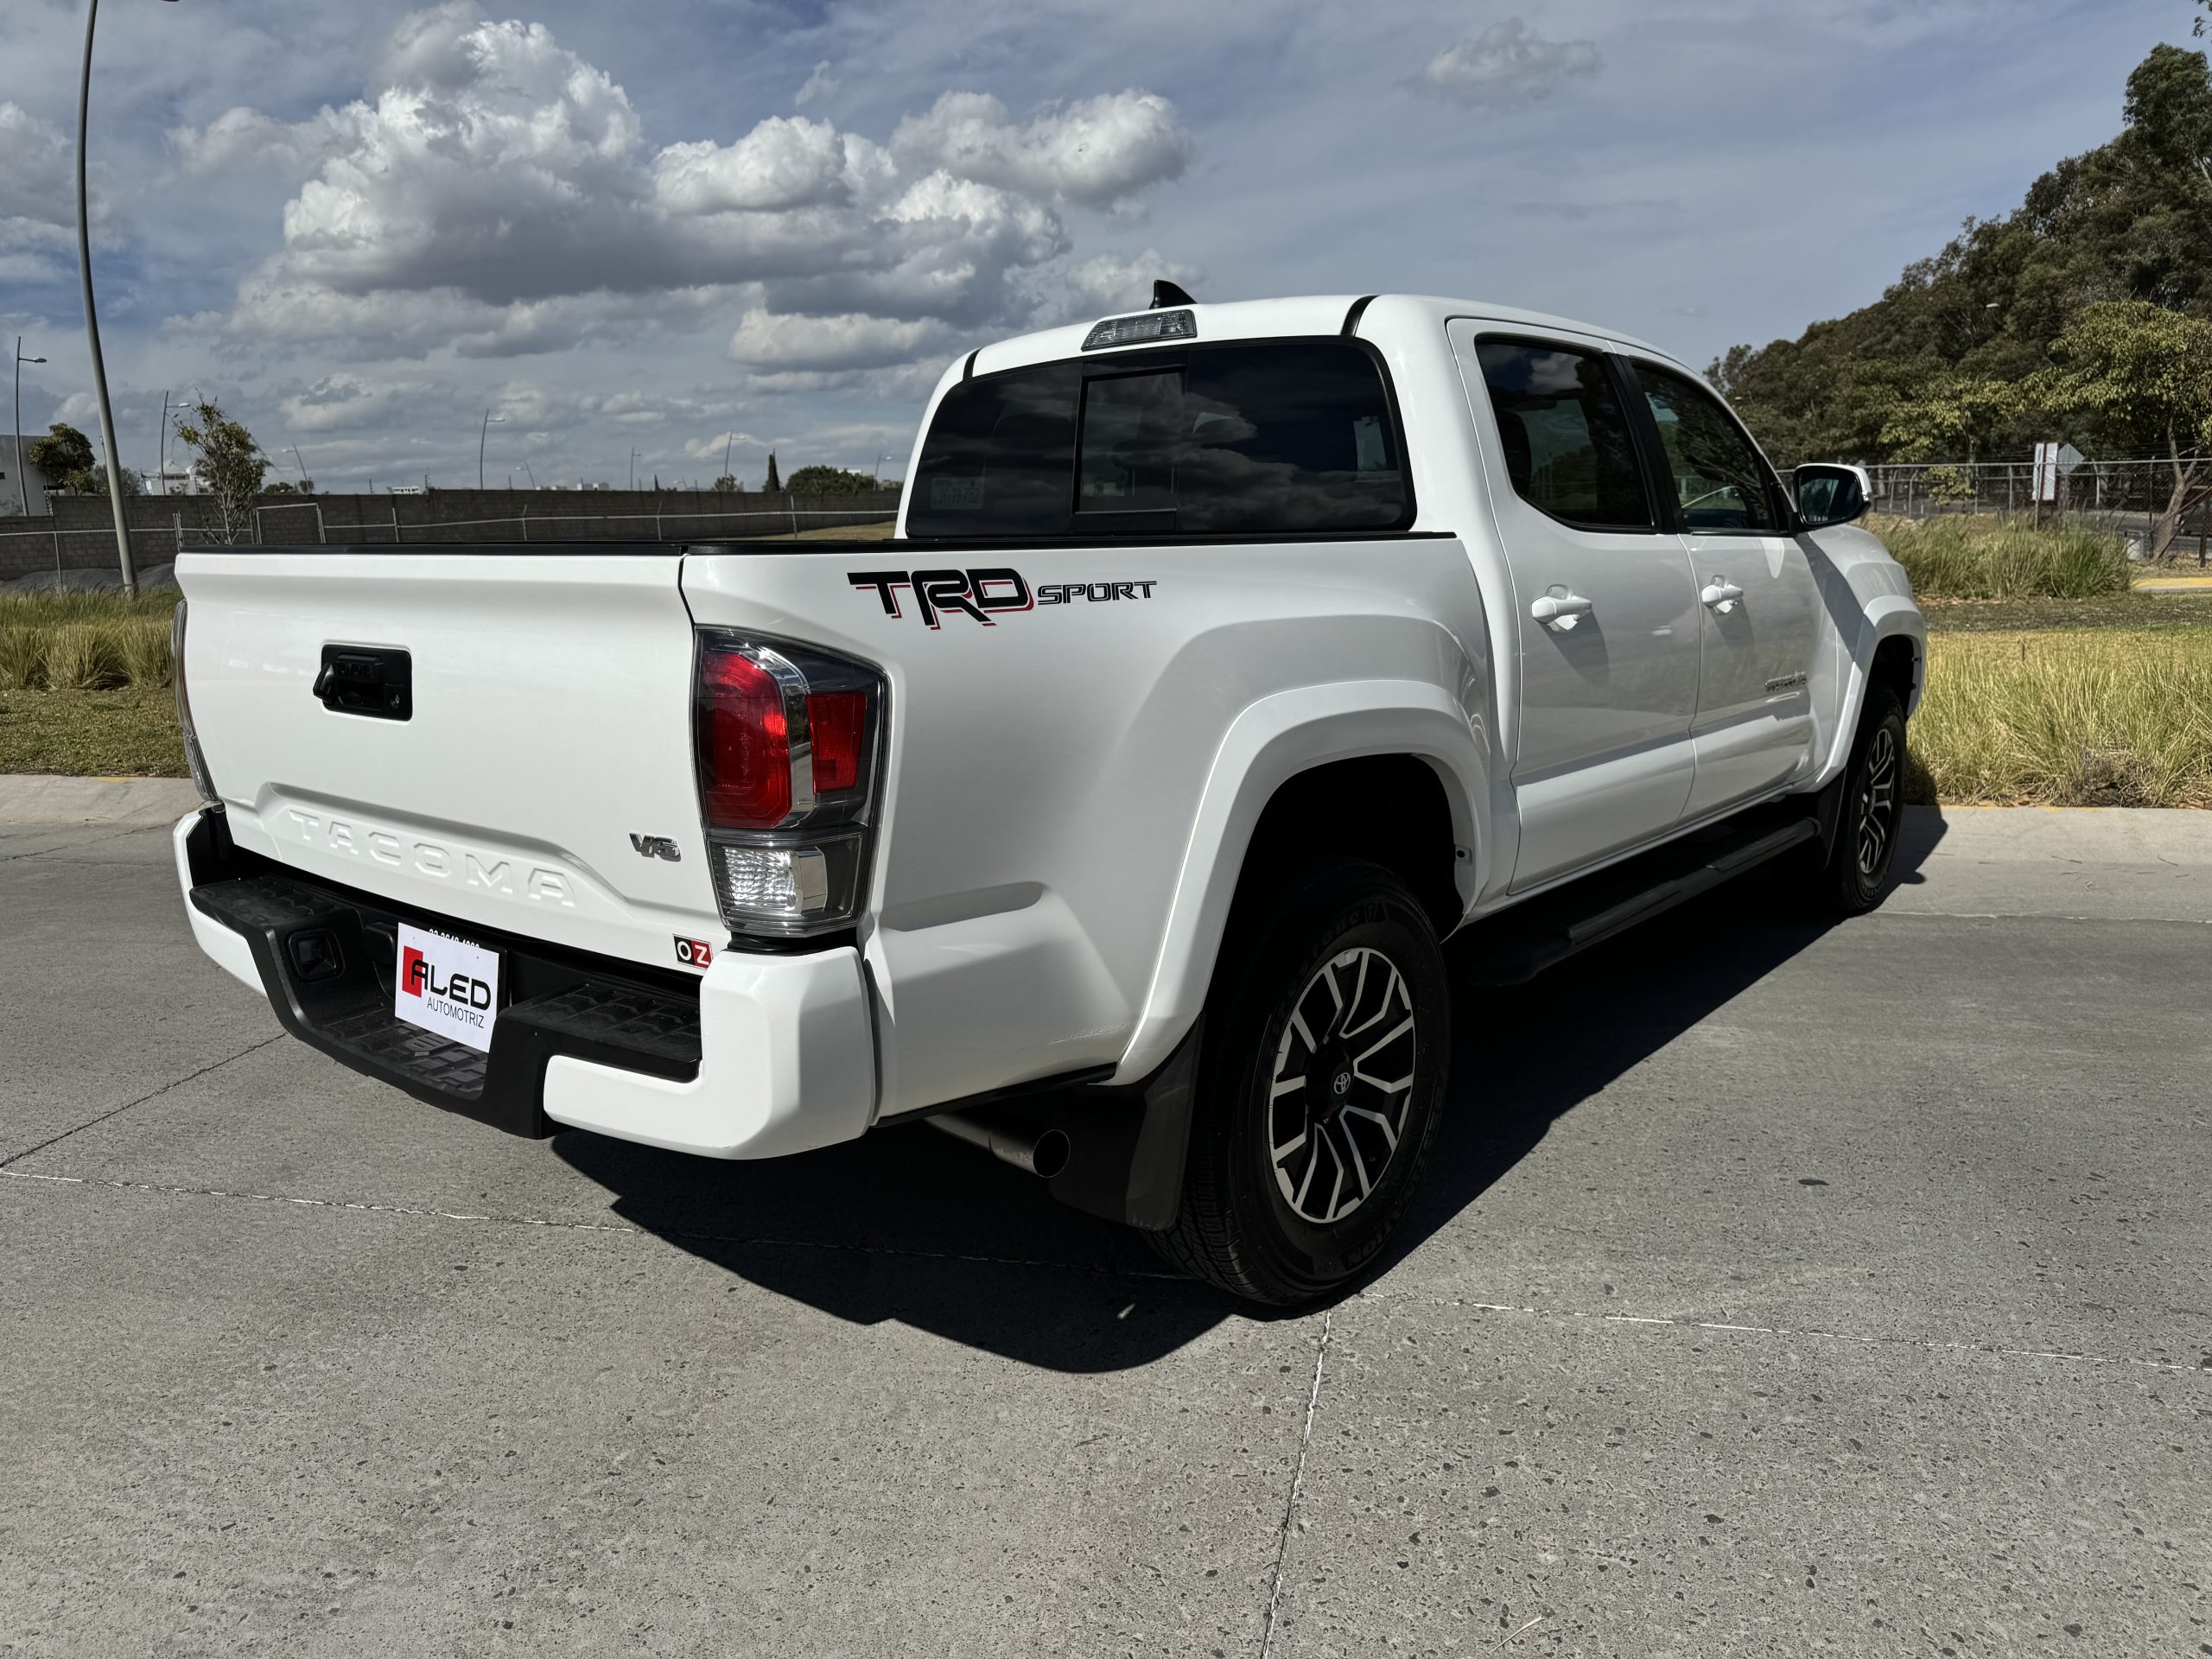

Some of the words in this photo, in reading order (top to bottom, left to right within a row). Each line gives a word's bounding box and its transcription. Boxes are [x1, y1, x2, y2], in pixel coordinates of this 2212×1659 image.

[847, 568, 1034, 631] TRD
[1037, 581, 1158, 606] SPORT
[289, 810, 575, 907] TACOMA
[629, 832, 682, 862] V6
[677, 940, 710, 966] OZ
[410, 958, 492, 1011] ALED
[427, 996, 485, 1029] AUTOMOTRIZ
